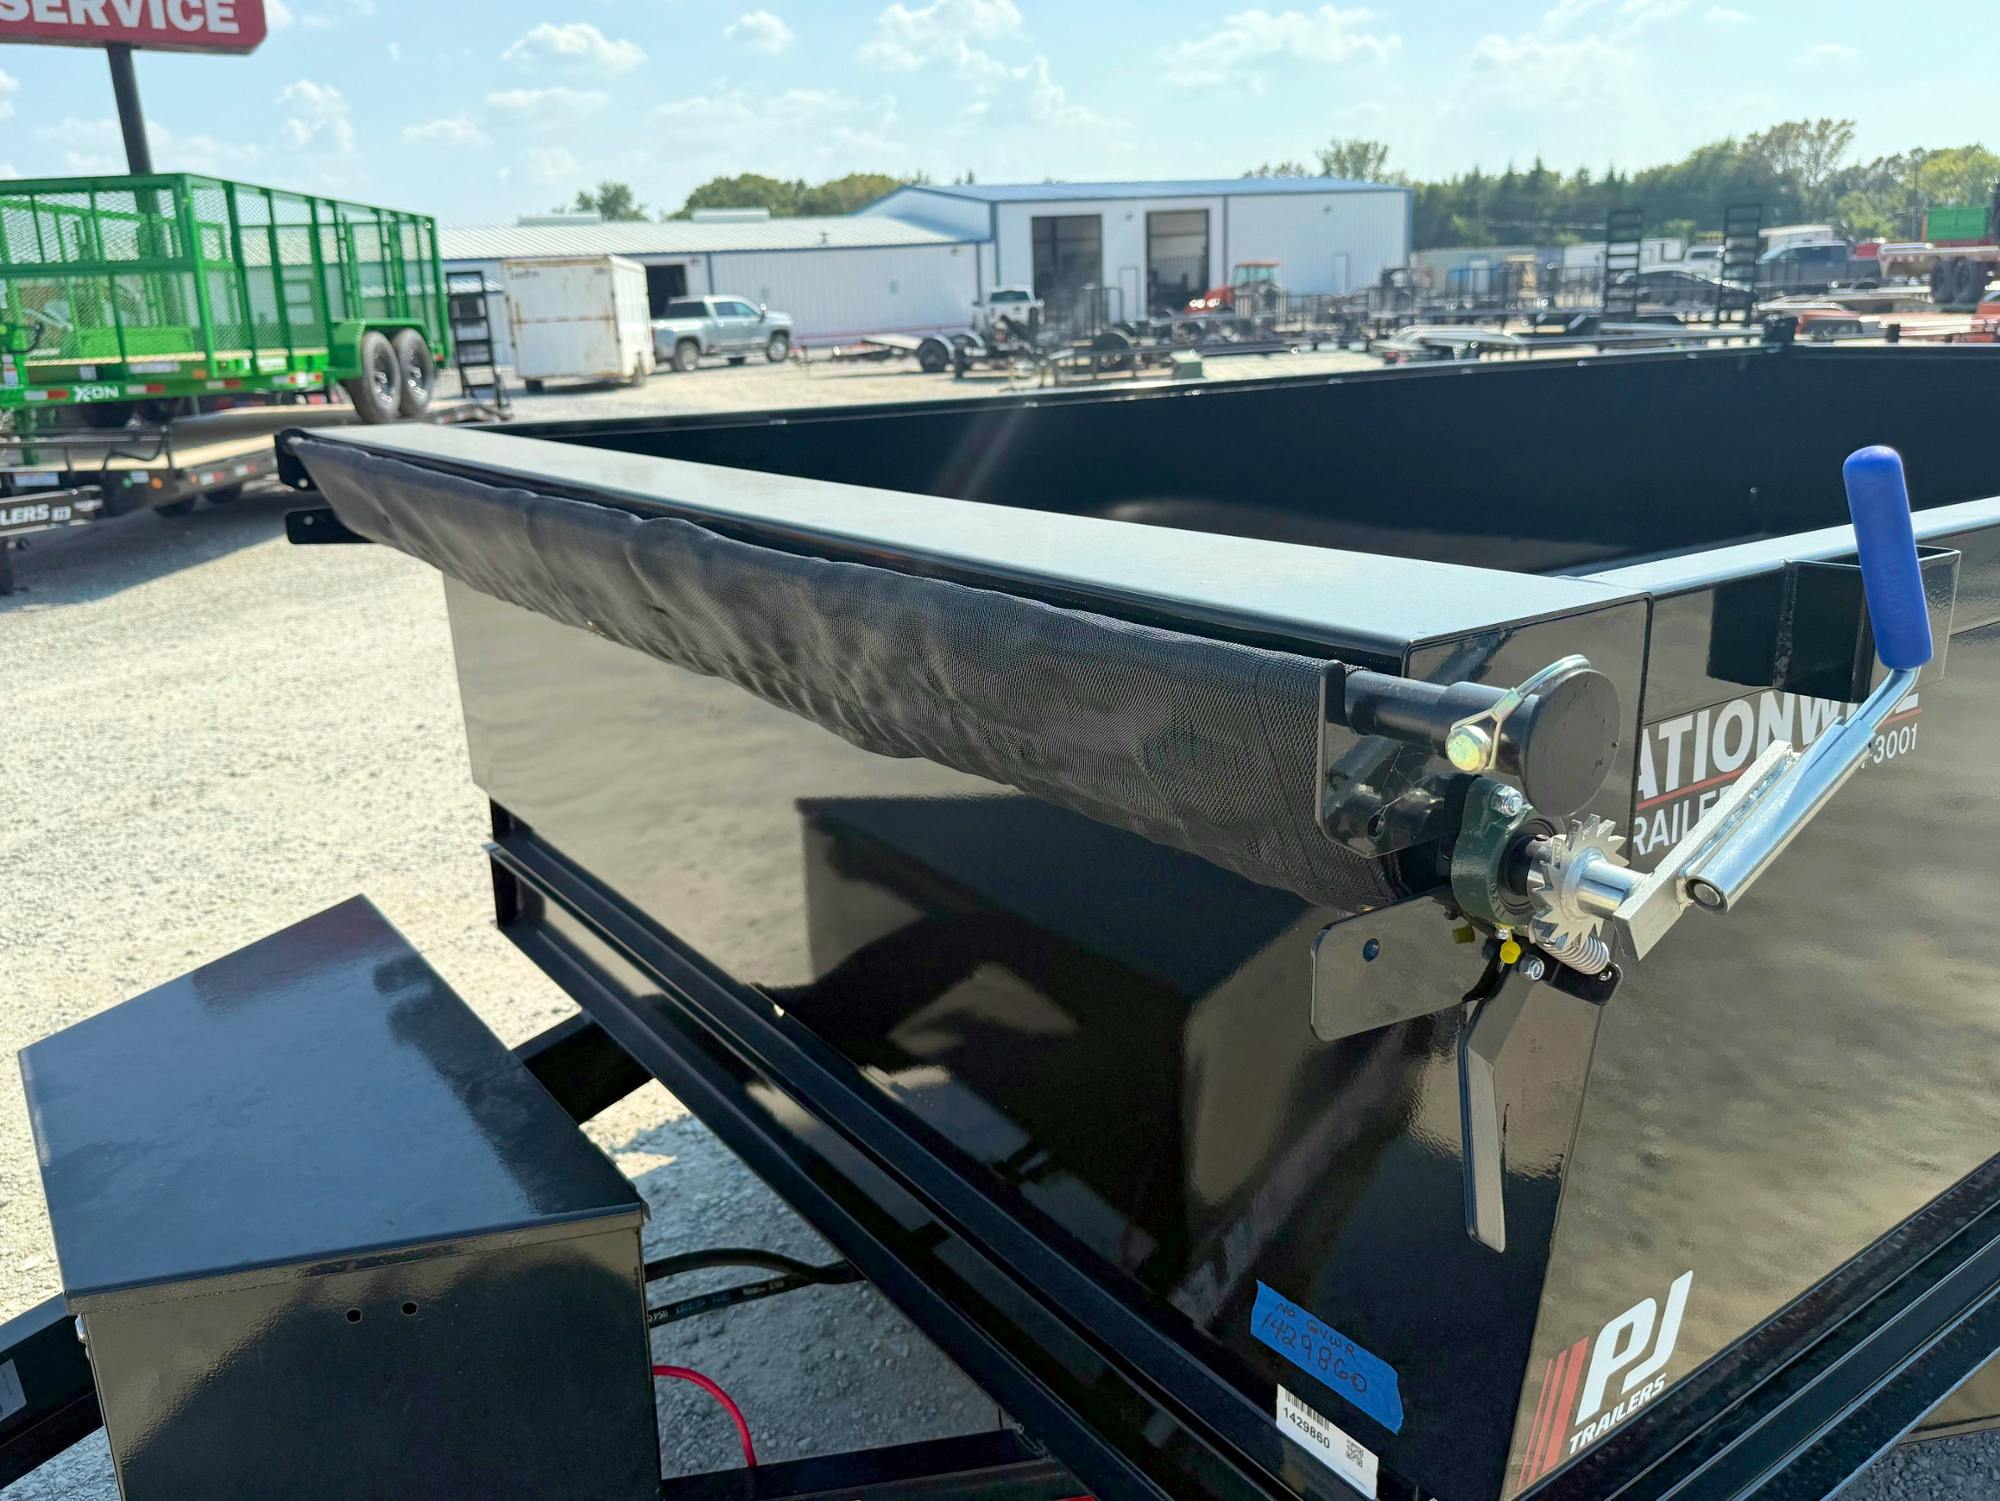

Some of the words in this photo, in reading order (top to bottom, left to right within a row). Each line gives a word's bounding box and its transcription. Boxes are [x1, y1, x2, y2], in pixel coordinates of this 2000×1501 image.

[0, 0, 239, 34] SERVICE
[1260, 1312, 1368, 1393] 1429860
[1575, 1270, 1693, 1426] PJ
[1283, 1406, 1331, 1449] 1429860
[1568, 1372, 1667, 1455] TRAILERS
